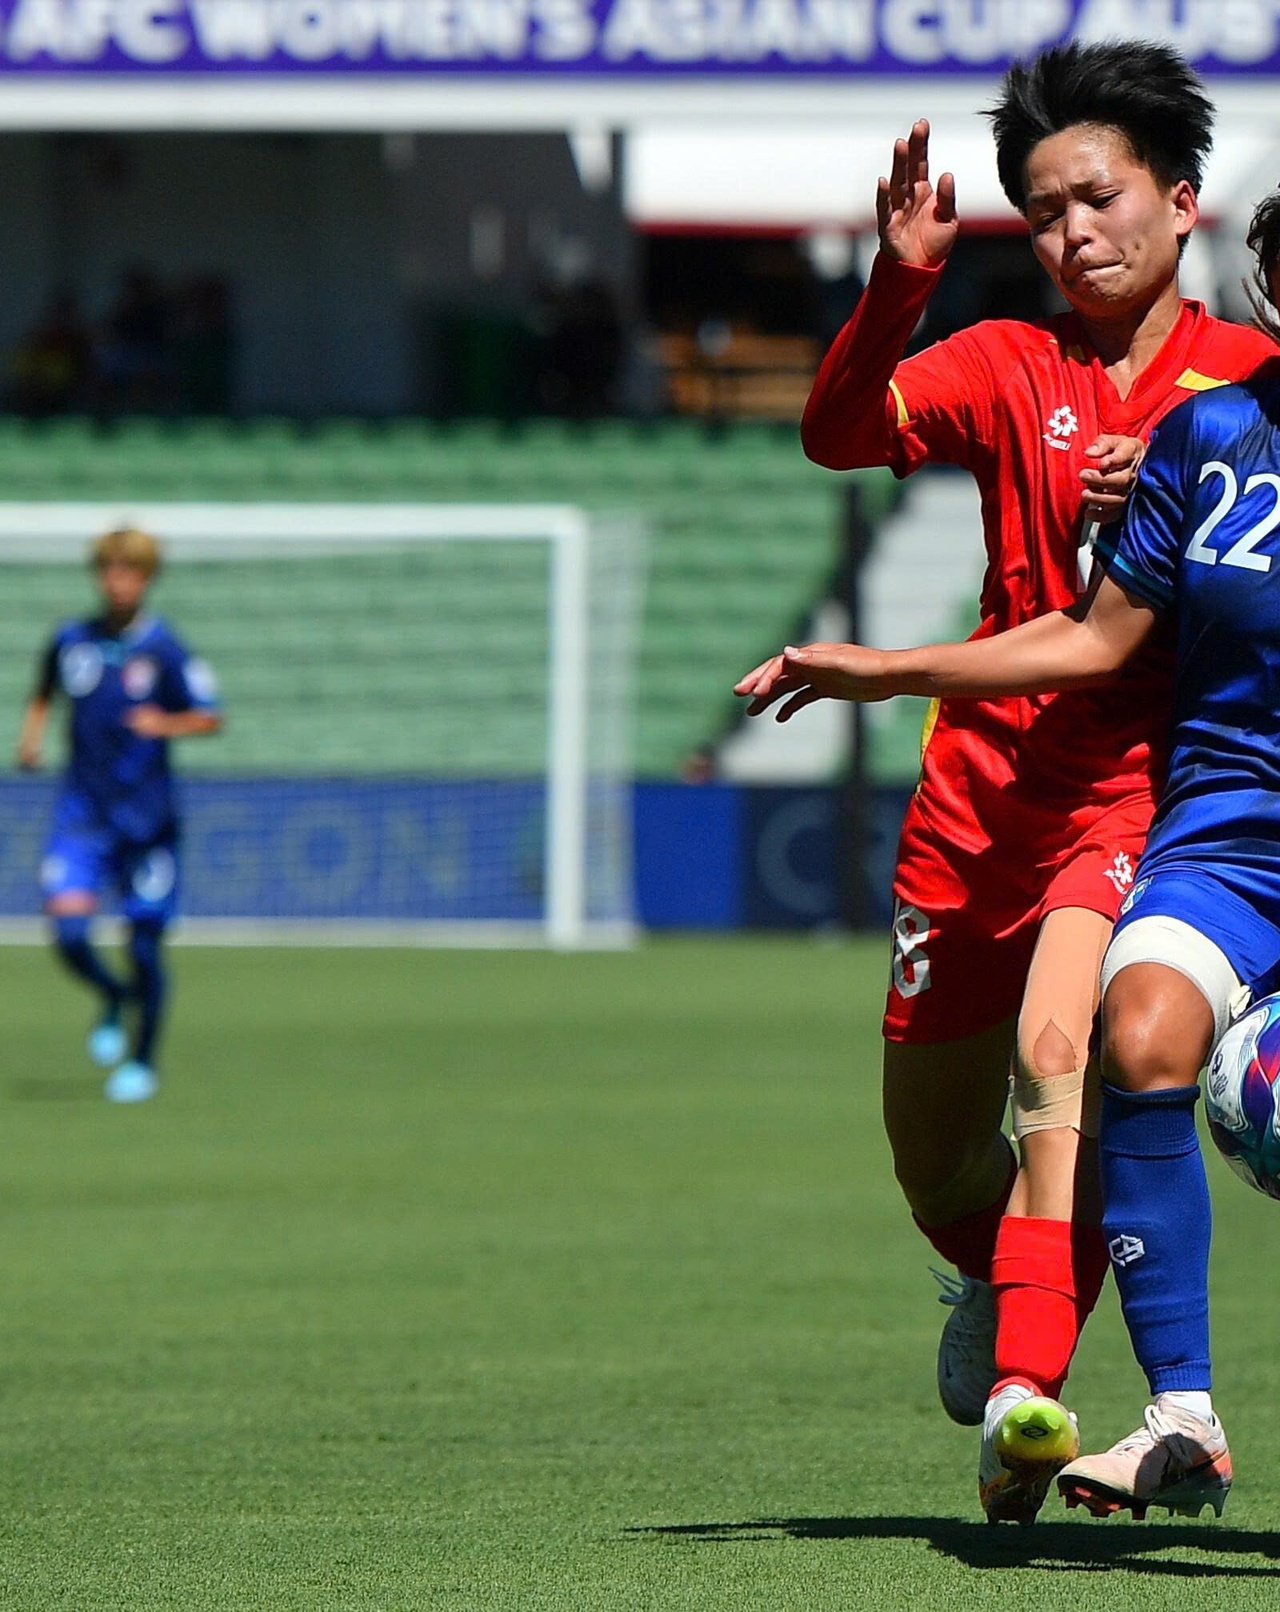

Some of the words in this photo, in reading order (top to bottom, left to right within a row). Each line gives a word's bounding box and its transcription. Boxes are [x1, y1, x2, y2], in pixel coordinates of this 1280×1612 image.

[7, 0, 188, 62] AFC
[191, 0, 597, 62] WOMEN'S
[604, 0, 876, 62] ASIAN
[880, 0, 1070, 63] CUP
